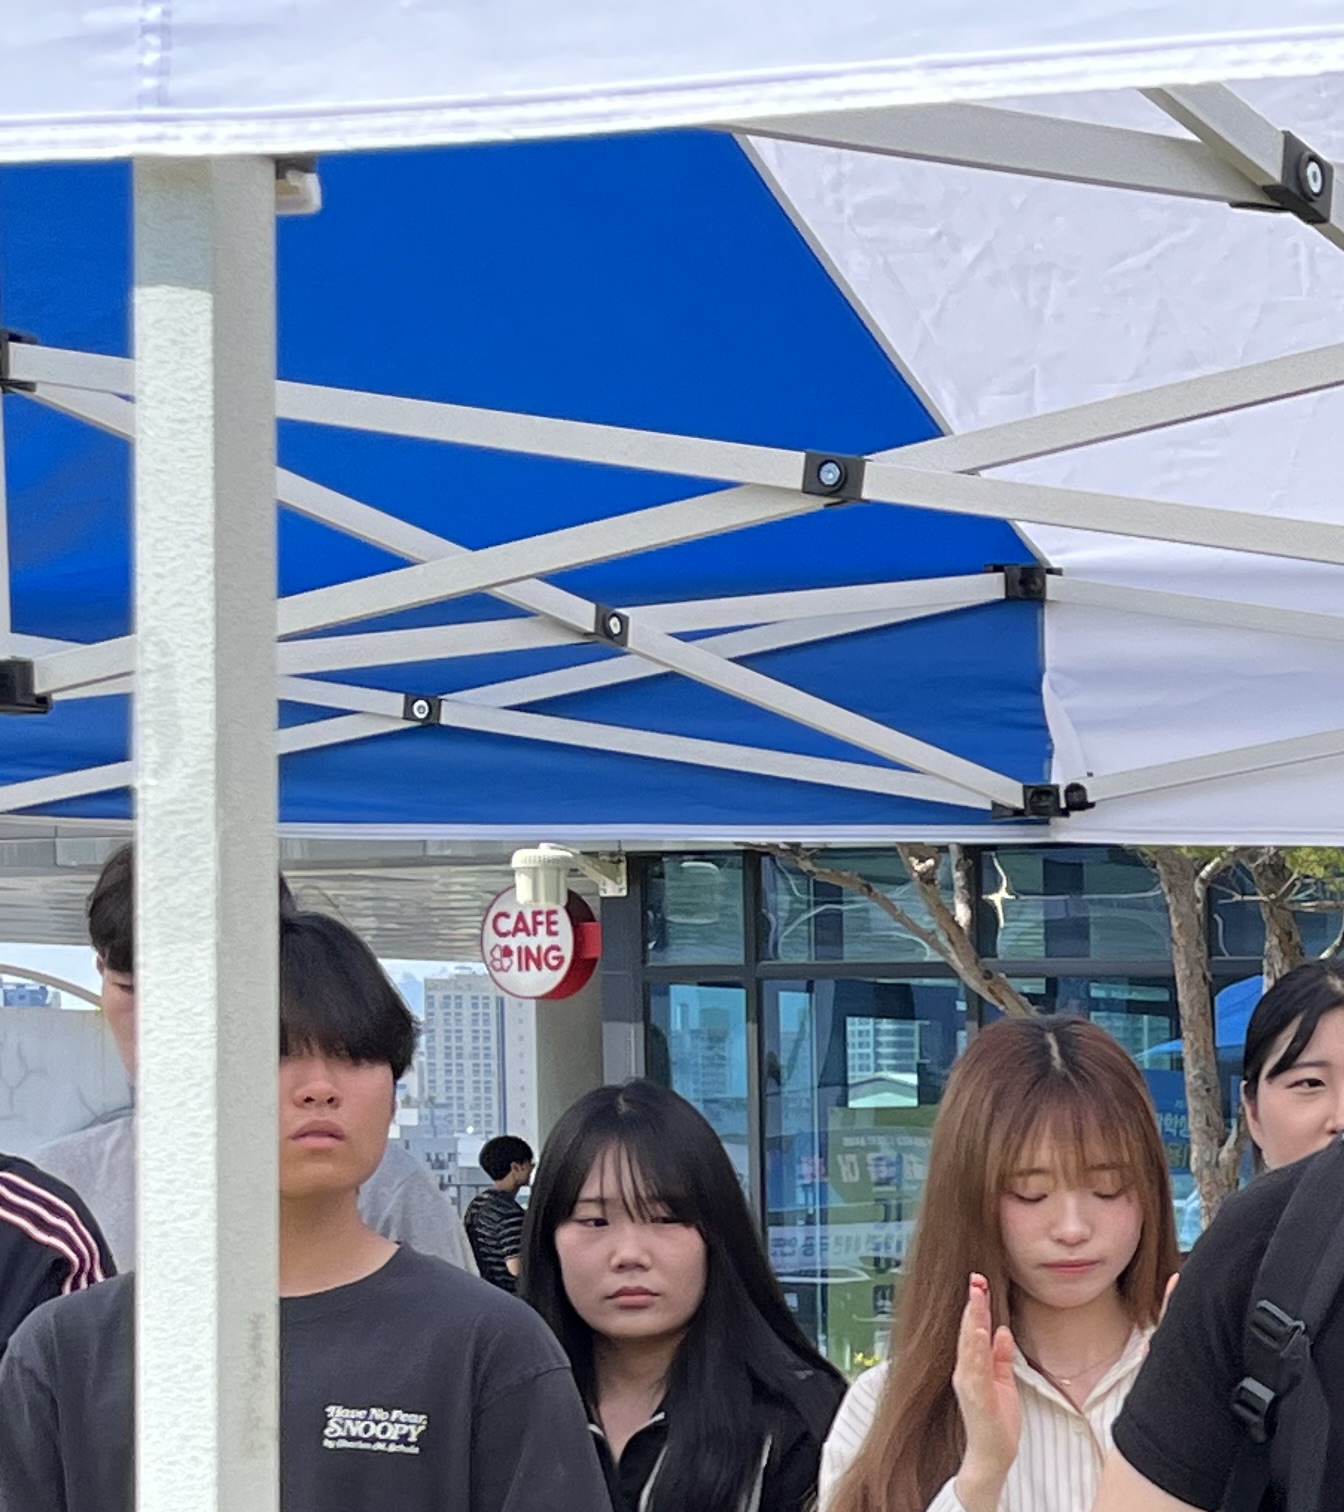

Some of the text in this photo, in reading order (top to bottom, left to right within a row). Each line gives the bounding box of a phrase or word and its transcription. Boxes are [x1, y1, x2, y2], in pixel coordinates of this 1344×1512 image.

[492, 909, 559, 938] CAFE
[517, 944, 565, 971] ING
[323, 1418, 426, 1442] SNOOPY
